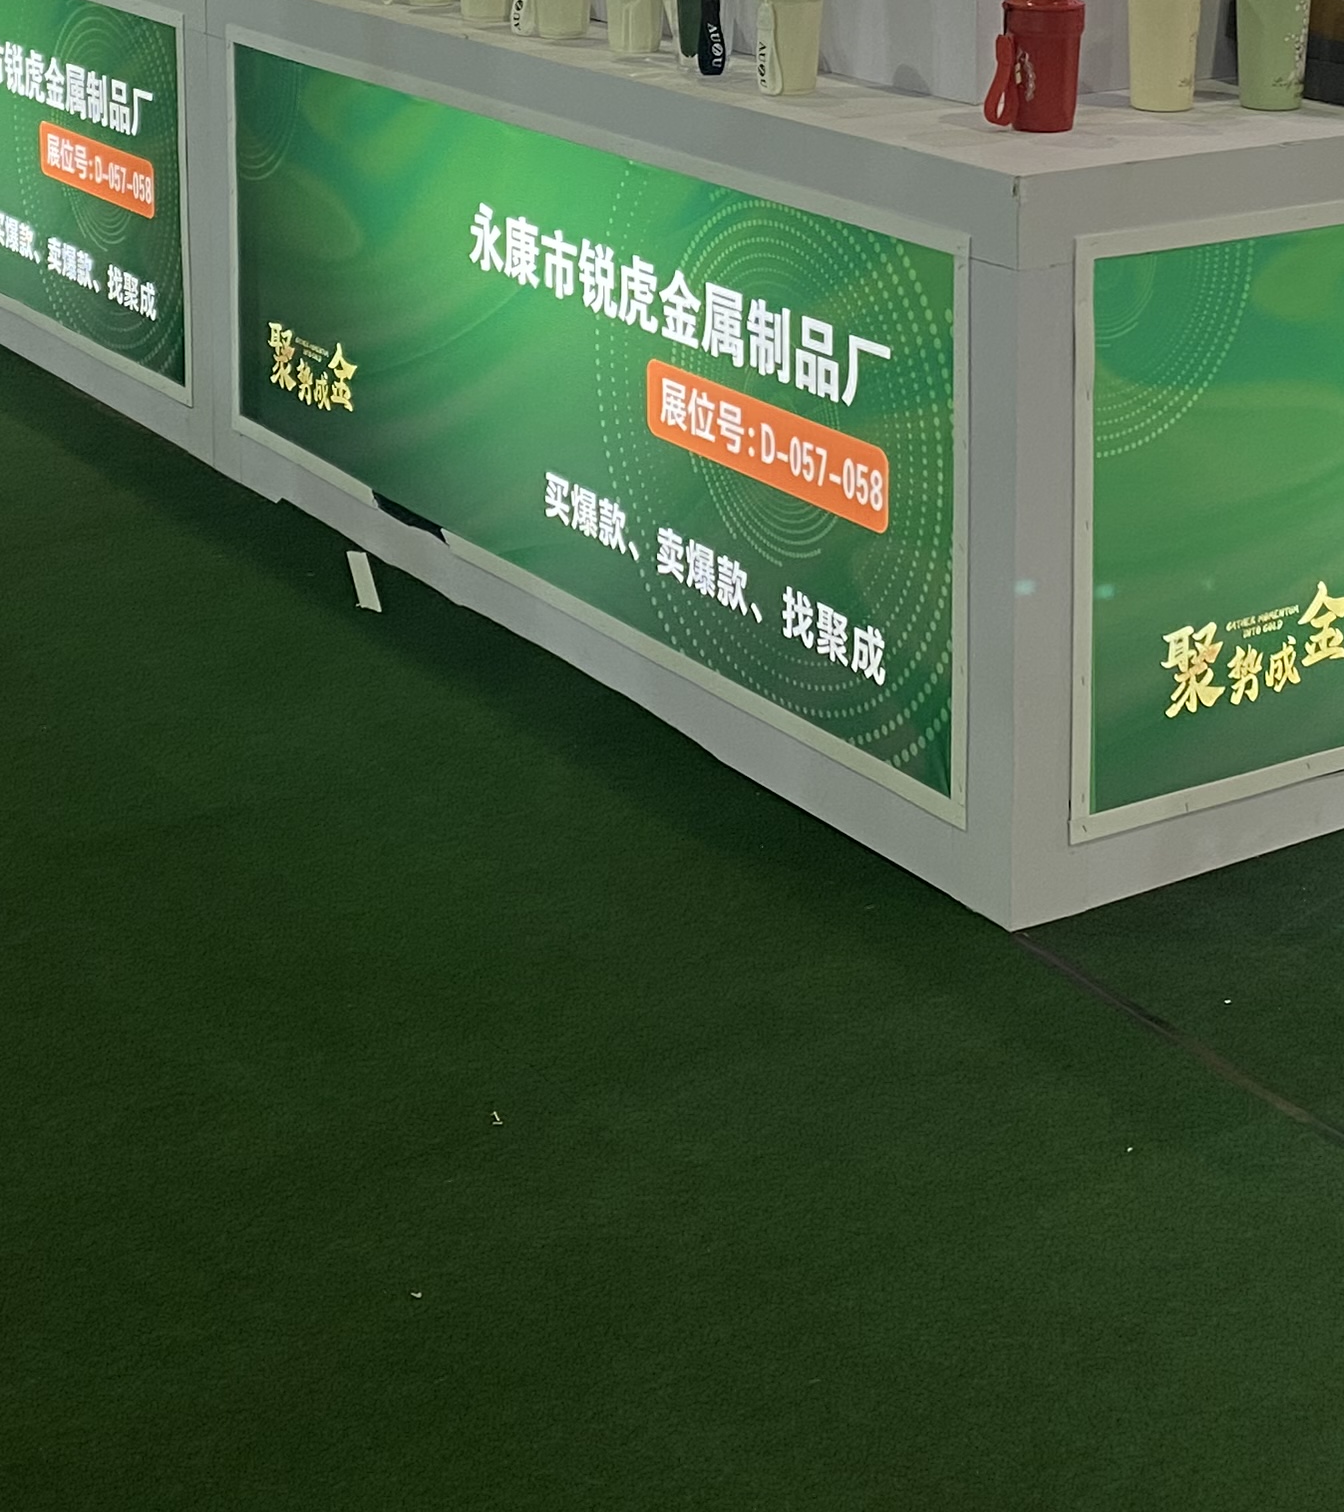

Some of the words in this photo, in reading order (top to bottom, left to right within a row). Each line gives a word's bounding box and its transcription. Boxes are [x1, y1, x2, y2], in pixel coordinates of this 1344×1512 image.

[468, 202, 892, 407] 永康市锐虎金属制品厂
[659, 377, 885, 512] 展位号:D-057-058
[543, 471, 887, 686] 买爆款、卖爆款、找聚成
